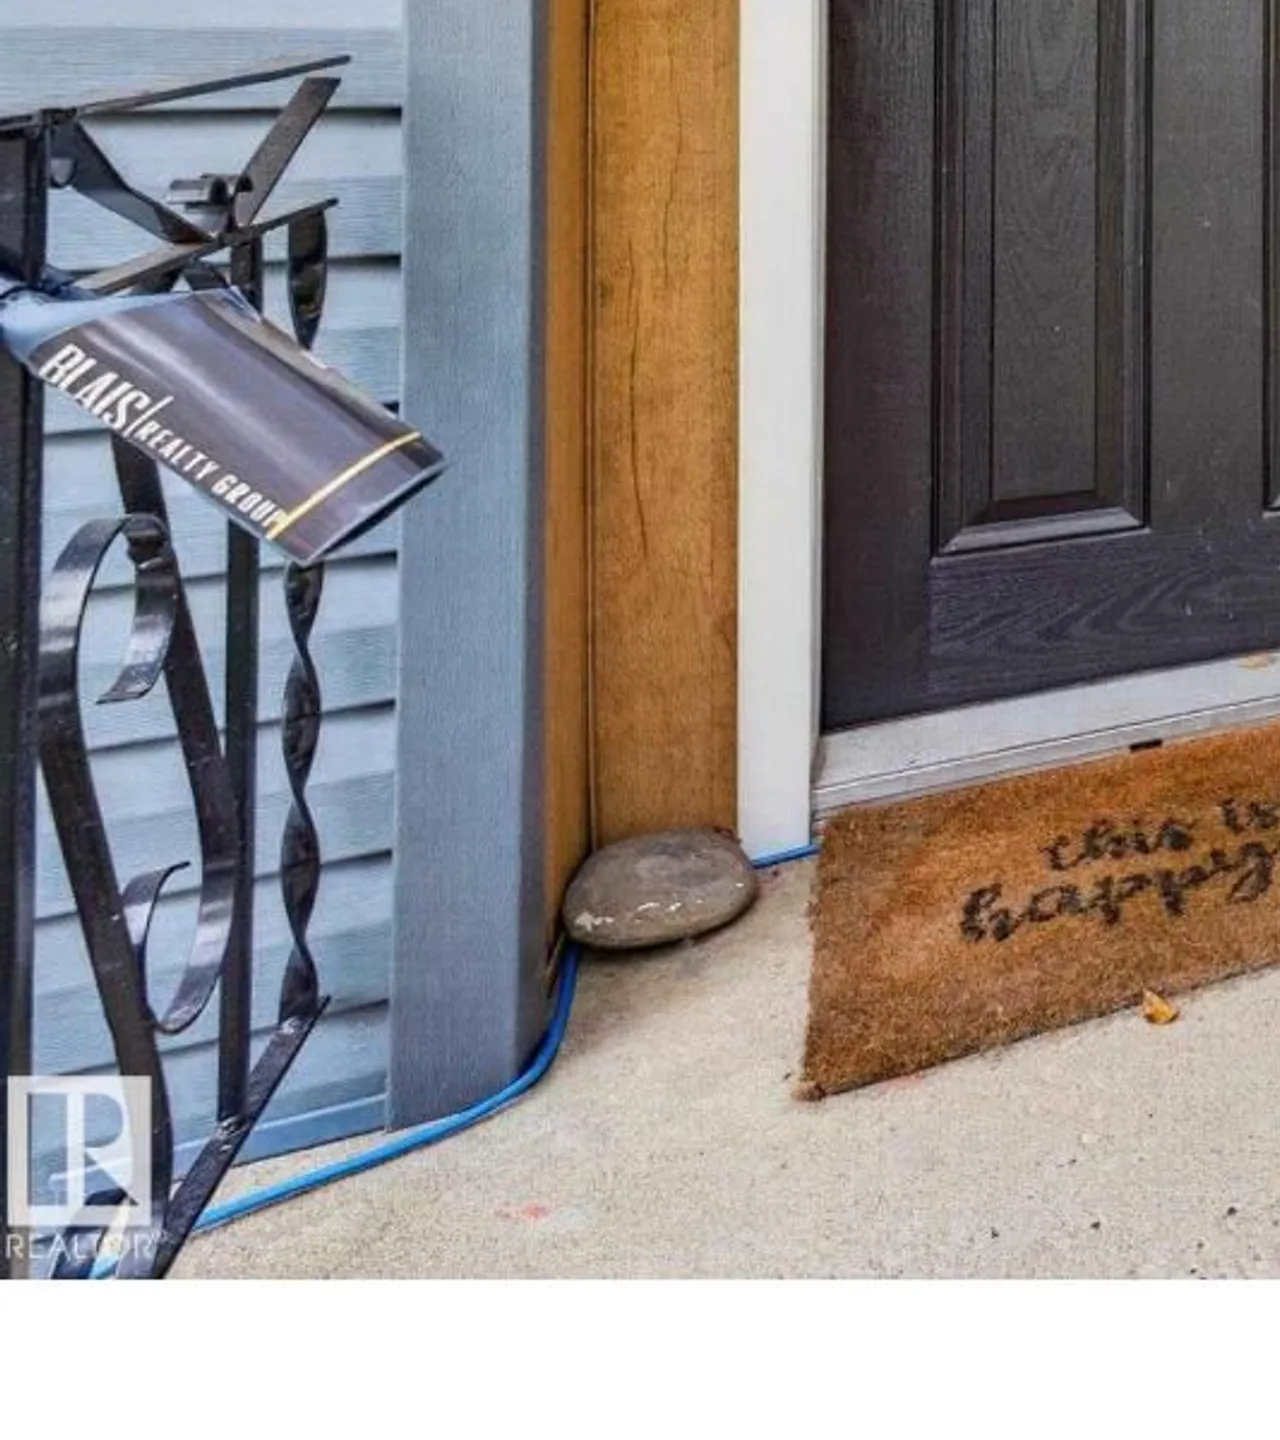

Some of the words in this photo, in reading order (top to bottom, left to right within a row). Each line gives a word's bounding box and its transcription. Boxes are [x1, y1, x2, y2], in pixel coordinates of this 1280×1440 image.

[135, 420, 220, 482] REALTY
[211, 473, 289, 528] GROUP
[1038, 818, 1196, 871] this
